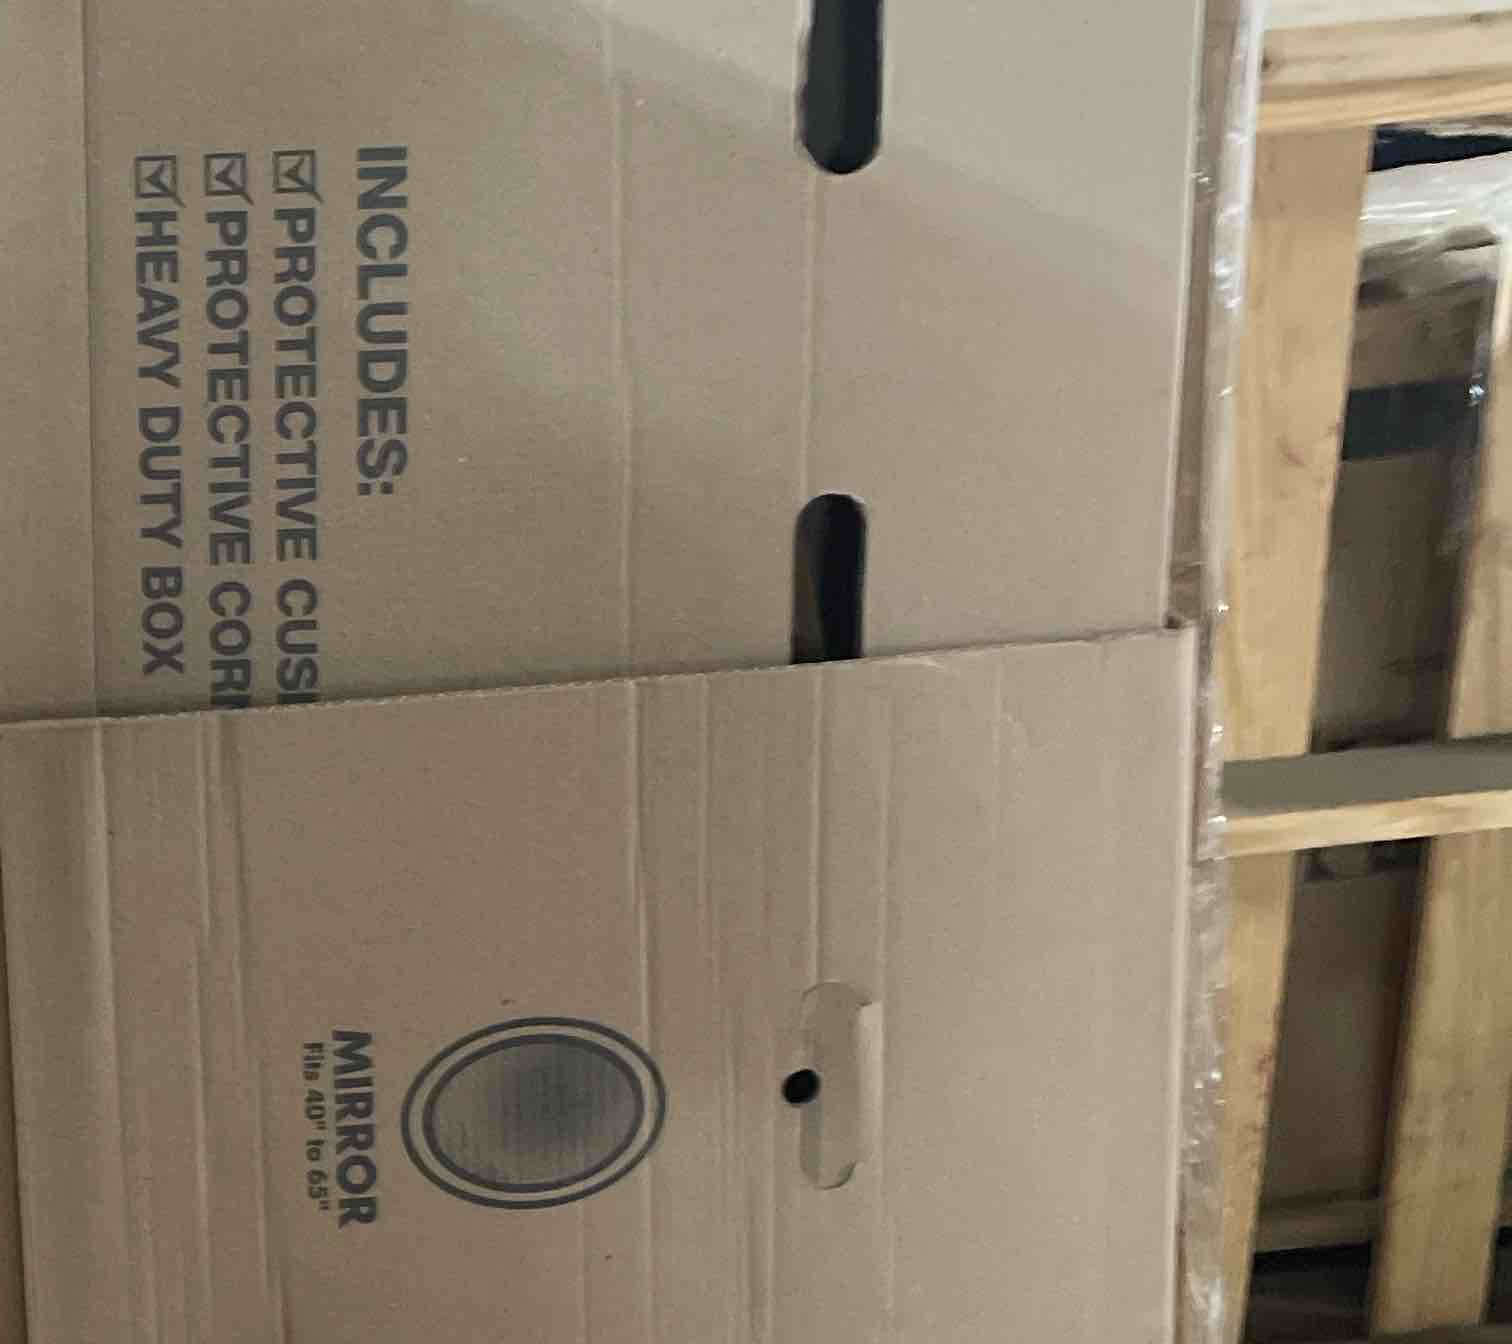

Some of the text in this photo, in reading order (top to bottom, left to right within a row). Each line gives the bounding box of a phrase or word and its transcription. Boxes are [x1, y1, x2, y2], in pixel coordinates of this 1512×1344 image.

[135, 210, 184, 676] HEAVY DUTY BOX
[205, 210, 251, 567] PROTECTIVE
[273, 208, 319, 704] PROTECTIVE CUS
[356, 146, 408, 496] INCLUDES:
[303, 1042, 324, 1081] Fits
[305, 1088, 327, 1131] 40"
[306, 1139, 324, 1162] to
[332, 1030, 377, 1230] MIRROR
